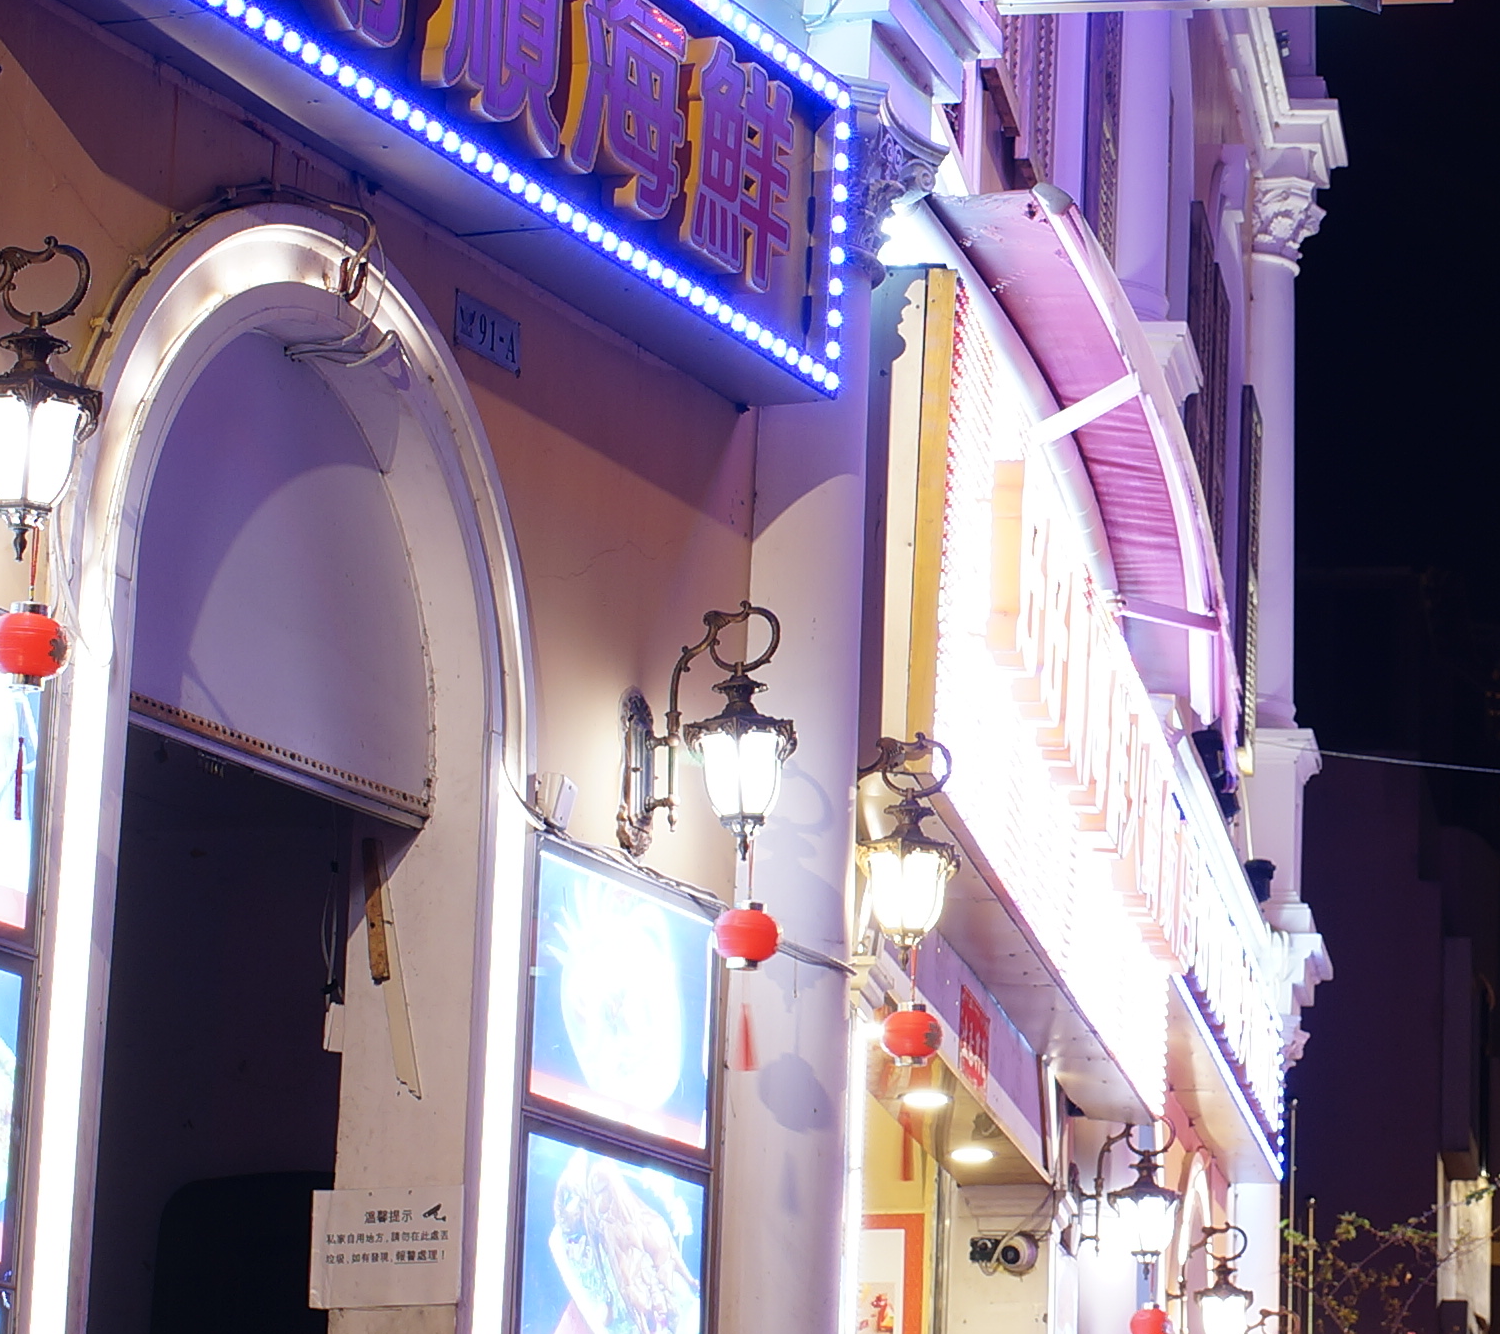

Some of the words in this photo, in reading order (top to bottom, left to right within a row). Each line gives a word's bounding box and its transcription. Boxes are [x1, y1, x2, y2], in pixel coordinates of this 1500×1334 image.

[479, 313, 516, 364] 91-A
[364, 1209, 413, 1224] 溫馨提示
